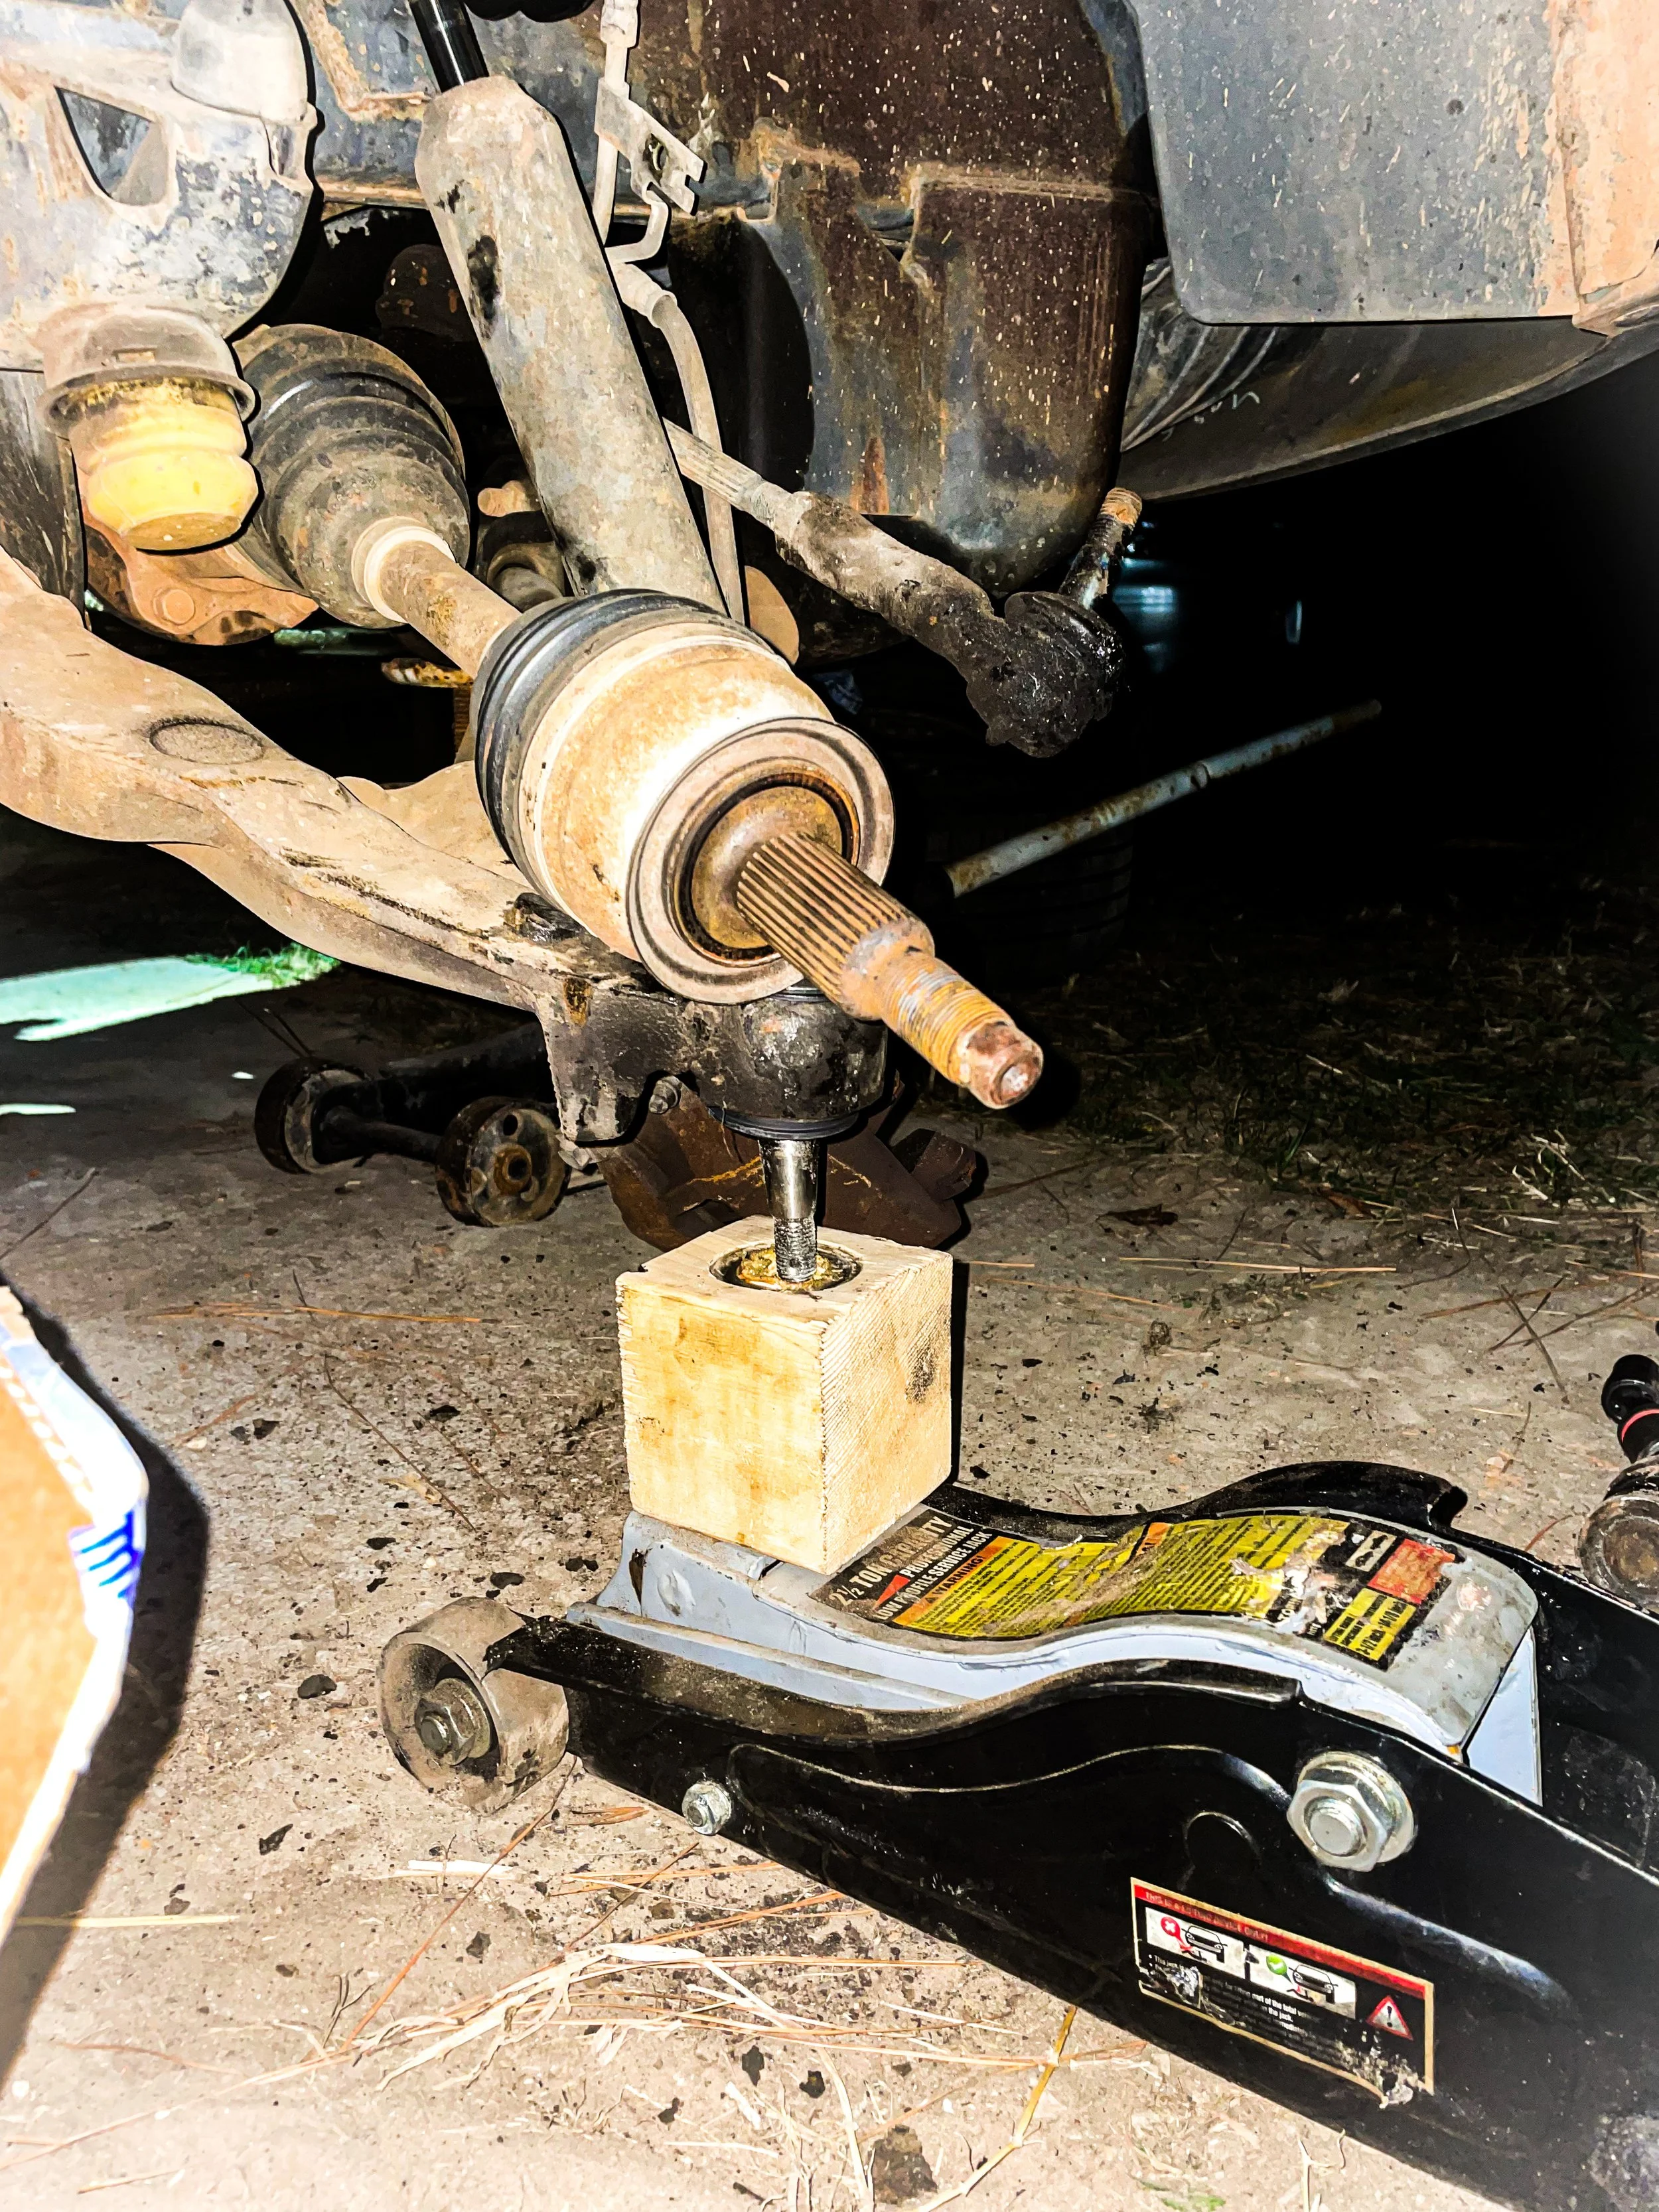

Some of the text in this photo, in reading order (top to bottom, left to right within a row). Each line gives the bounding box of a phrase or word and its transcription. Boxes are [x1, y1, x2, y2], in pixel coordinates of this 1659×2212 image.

[899, 1526, 974, 1578] PROFESSIONAL
[849, 1562, 893, 1588] TON
[873, 1530, 993, 1620] LOW POFILE SERVICE JACK
[933, 1555, 985, 1595] WARNING!
[1268, 2007, 1278, 2017] the
[1272, 2000, 1282, 2010] the
[1283, 2004, 1297, 2016] total
